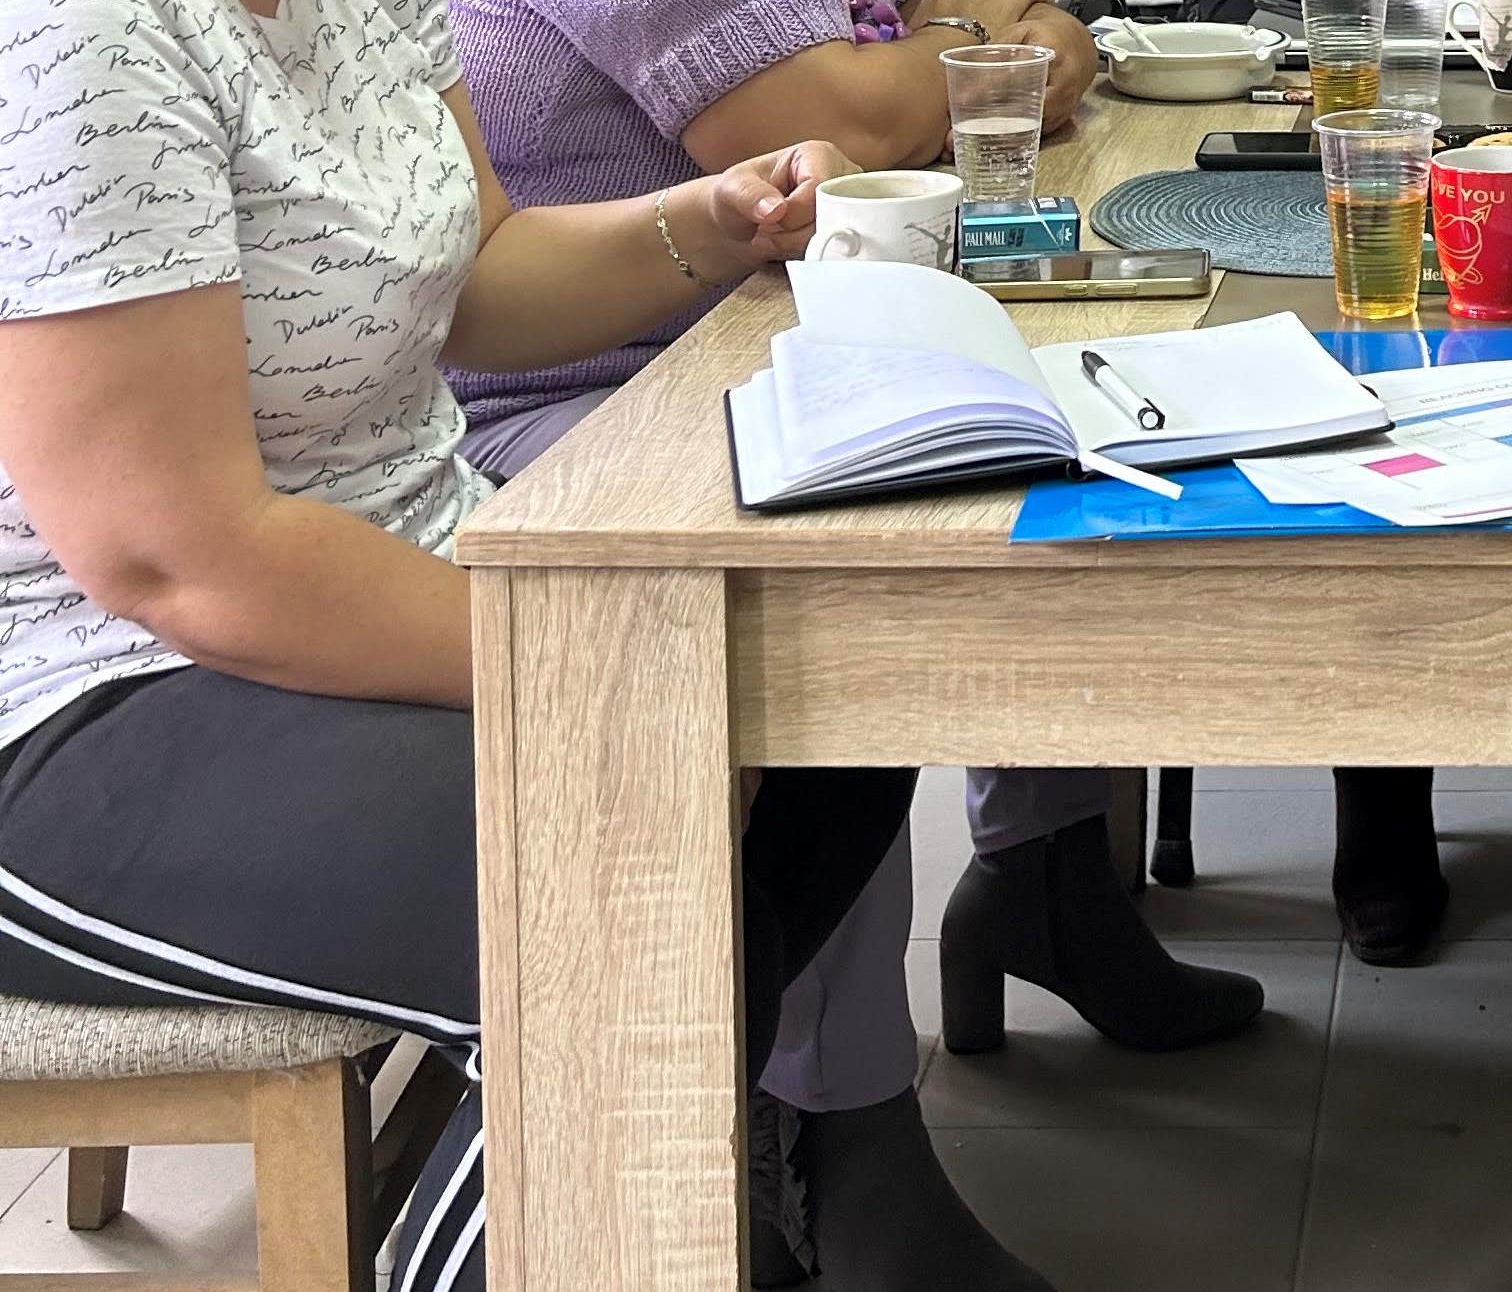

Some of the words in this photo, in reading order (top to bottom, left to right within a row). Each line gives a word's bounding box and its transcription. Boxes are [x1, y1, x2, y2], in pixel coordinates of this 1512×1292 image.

[98, 44, 167, 72] Paris
[75, 110, 180, 146] Berlin
[124, 181, 196, 212] Paris
[1461, 189, 1505, 205] YOU
[964, 231, 984, 248] PALL
[984, 230, 1006, 246] MALL
[103, 248, 204, 289] Berlin
[312, 246, 397, 275] Berlin
[349, 314, 400, 342] Paris
